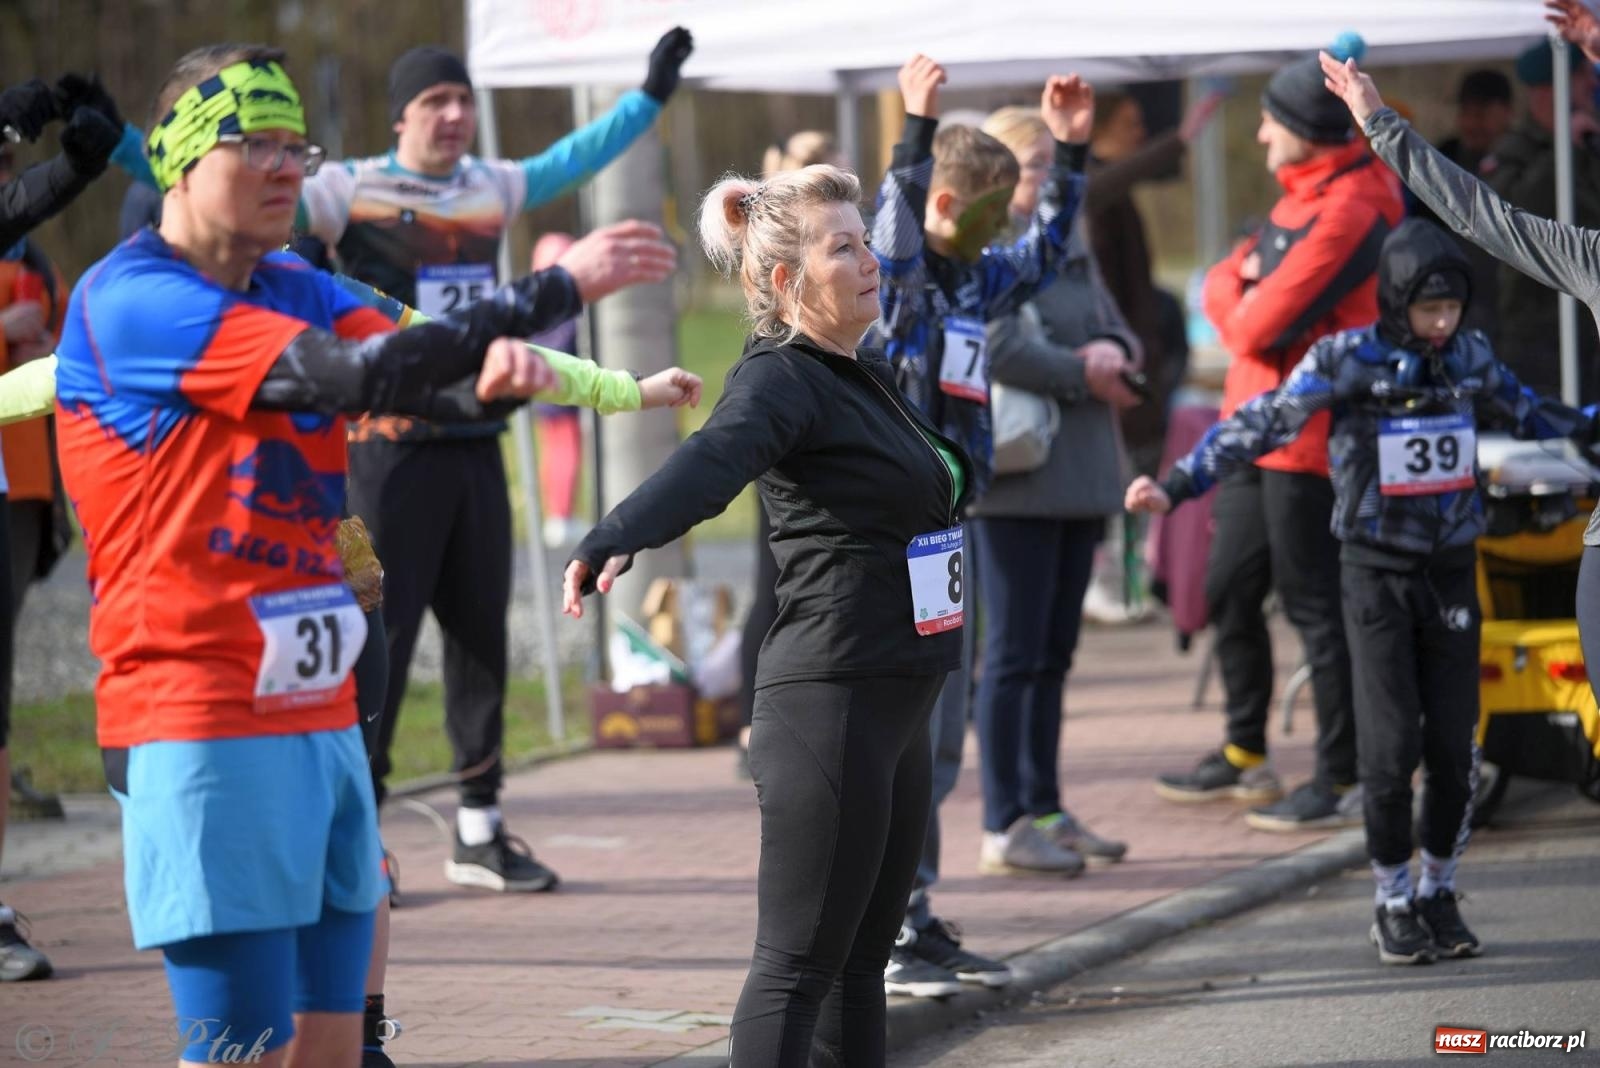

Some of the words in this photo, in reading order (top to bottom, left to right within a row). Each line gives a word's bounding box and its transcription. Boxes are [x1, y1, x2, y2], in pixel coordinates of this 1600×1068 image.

[964, 339, 980, 377] 7
[1404, 434, 1459, 473] 39
[918, 537, 928, 547] XII
[930, 534, 948, 545] BIEG
[948, 551, 962, 604] 8
[295, 613, 341, 680] 31
